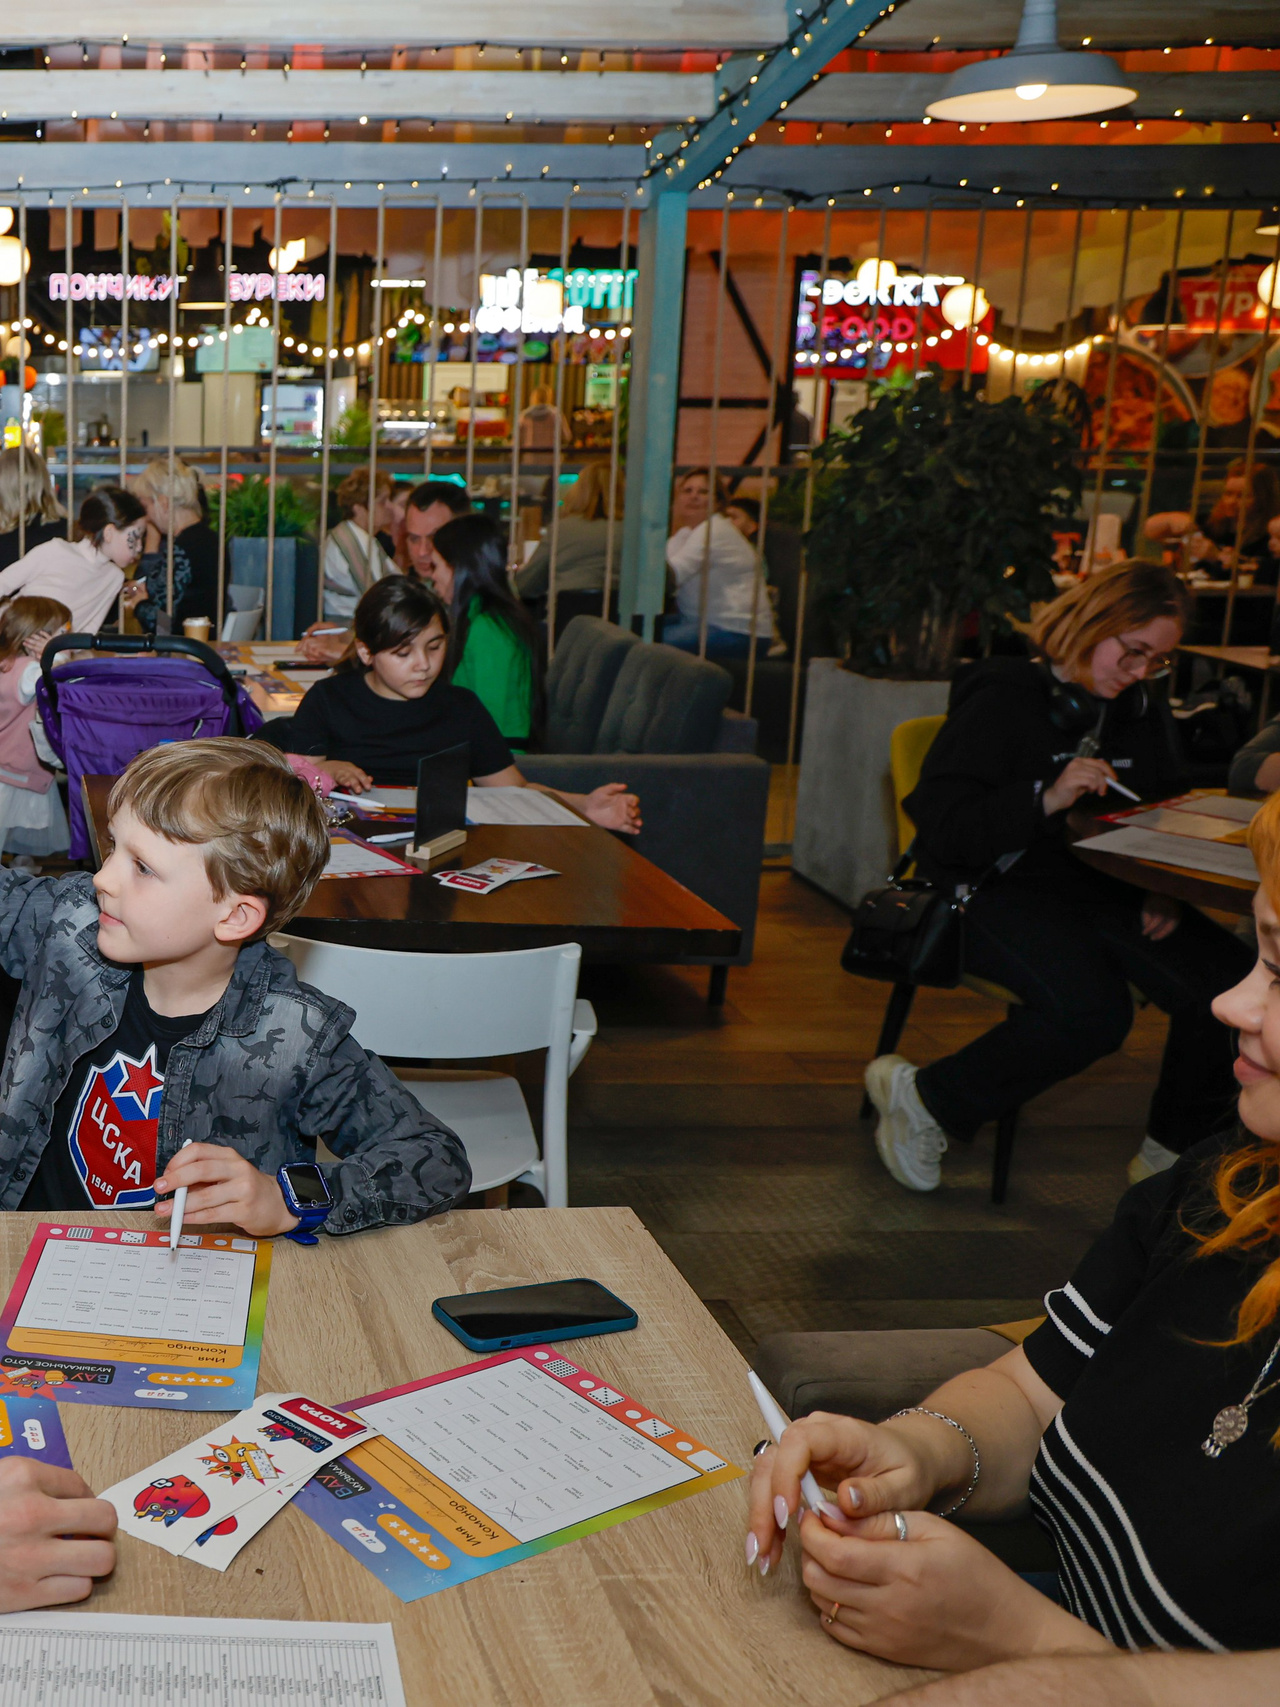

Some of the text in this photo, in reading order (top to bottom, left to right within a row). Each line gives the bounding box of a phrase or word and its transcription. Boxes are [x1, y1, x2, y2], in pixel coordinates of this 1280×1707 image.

[228, 273, 326, 301] БУРЕКИ
[821, 316, 916, 341] FOOD
[90, 1096, 142, 1186] ЦСКА
[91, 1174, 114, 1196] 1946
[167, 1343, 226, 1354] Команда
[4, 1357, 111, 1372] МУЗЫКАЛЬНОЕ ЛОТО
[69, 1372, 110, 1384] ВАУ
[265, 1408, 285, 1421] ЛОТО
[299, 1403, 347, 1429] НОРА
[294, 1437, 322, 1454] ВАУ
[316, 1475, 352, 1500] ВАУ
[449, 1500, 499, 1539] Команда
[455, 1526, 481, 1546] Имя
